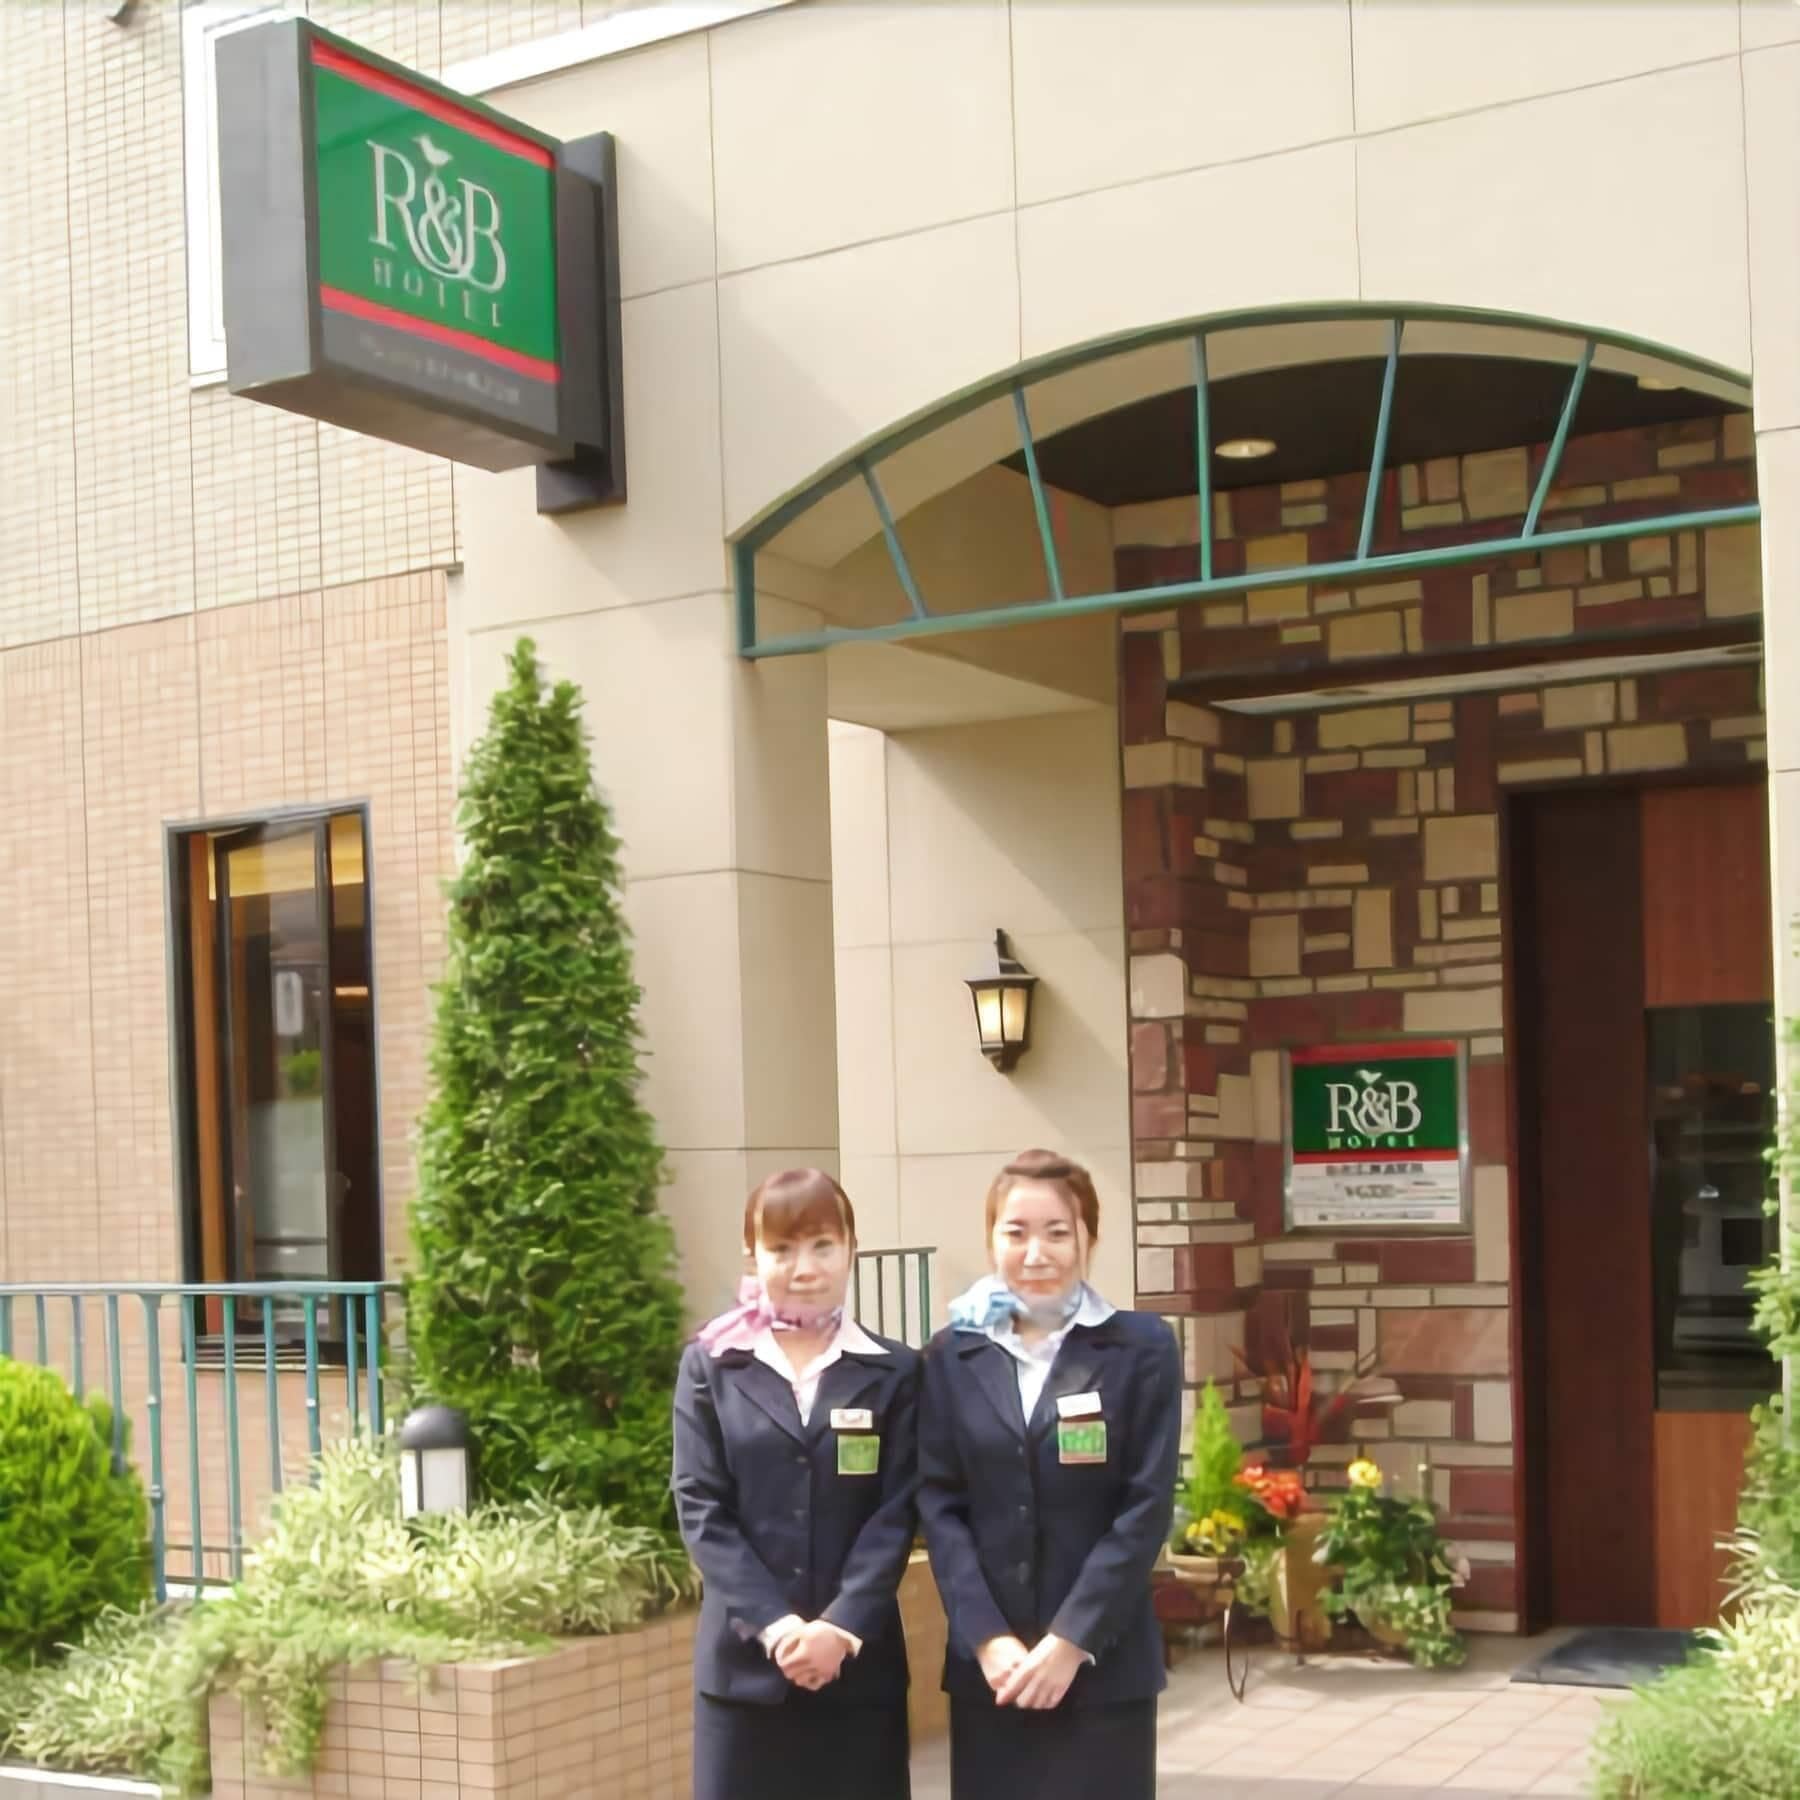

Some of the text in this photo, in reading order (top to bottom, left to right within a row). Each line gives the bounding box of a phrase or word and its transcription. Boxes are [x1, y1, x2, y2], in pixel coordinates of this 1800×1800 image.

[366, 139, 507, 293] R&B
[373, 257, 503, 328] HOTEL
[1324, 1080, 1422, 1137] R&B
[1328, 1134, 1417, 1150] HOTEL
